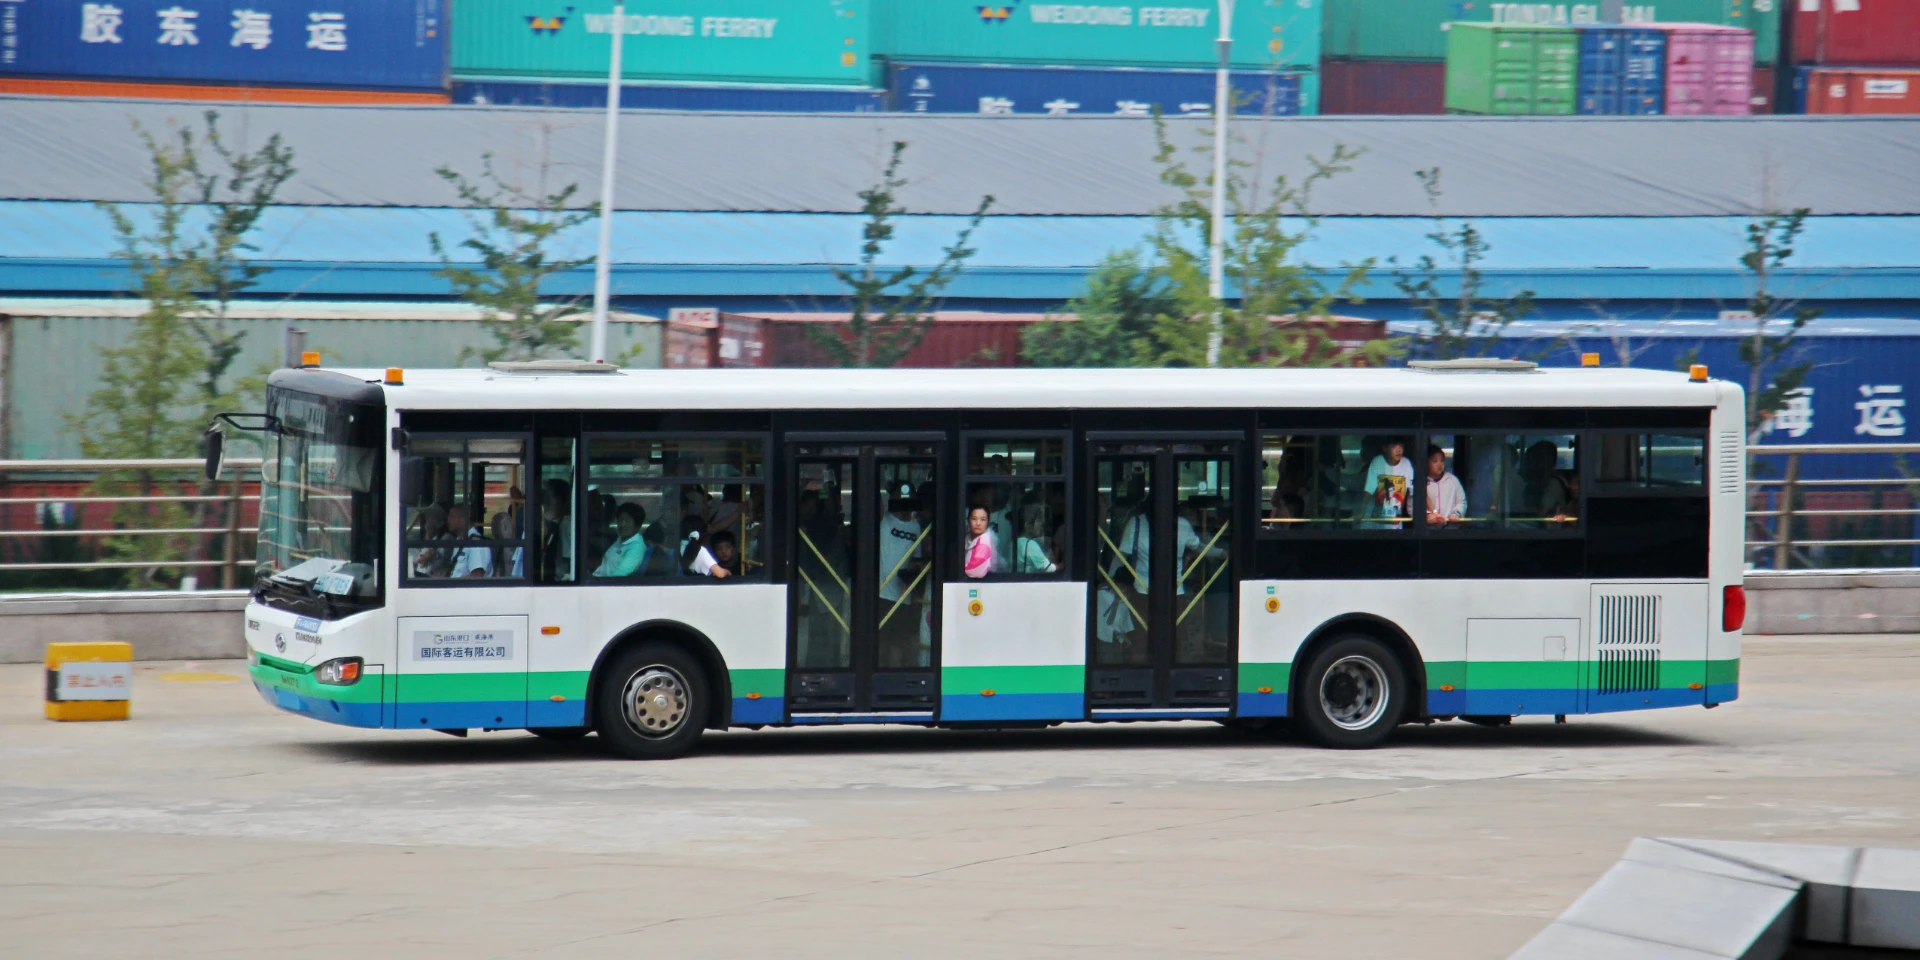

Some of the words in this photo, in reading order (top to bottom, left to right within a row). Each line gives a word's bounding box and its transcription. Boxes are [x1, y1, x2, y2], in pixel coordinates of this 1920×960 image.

[79, 2, 348, 51] 胶东海运
[583, 13, 694, 37] WEDONG
[701, 16, 778, 38] FERRY
[1029, 4, 1133, 26] WEIDONG
[1139, 6, 1210, 27] FERRY
[421, 646, 505, 658] 国际客运有限公司
